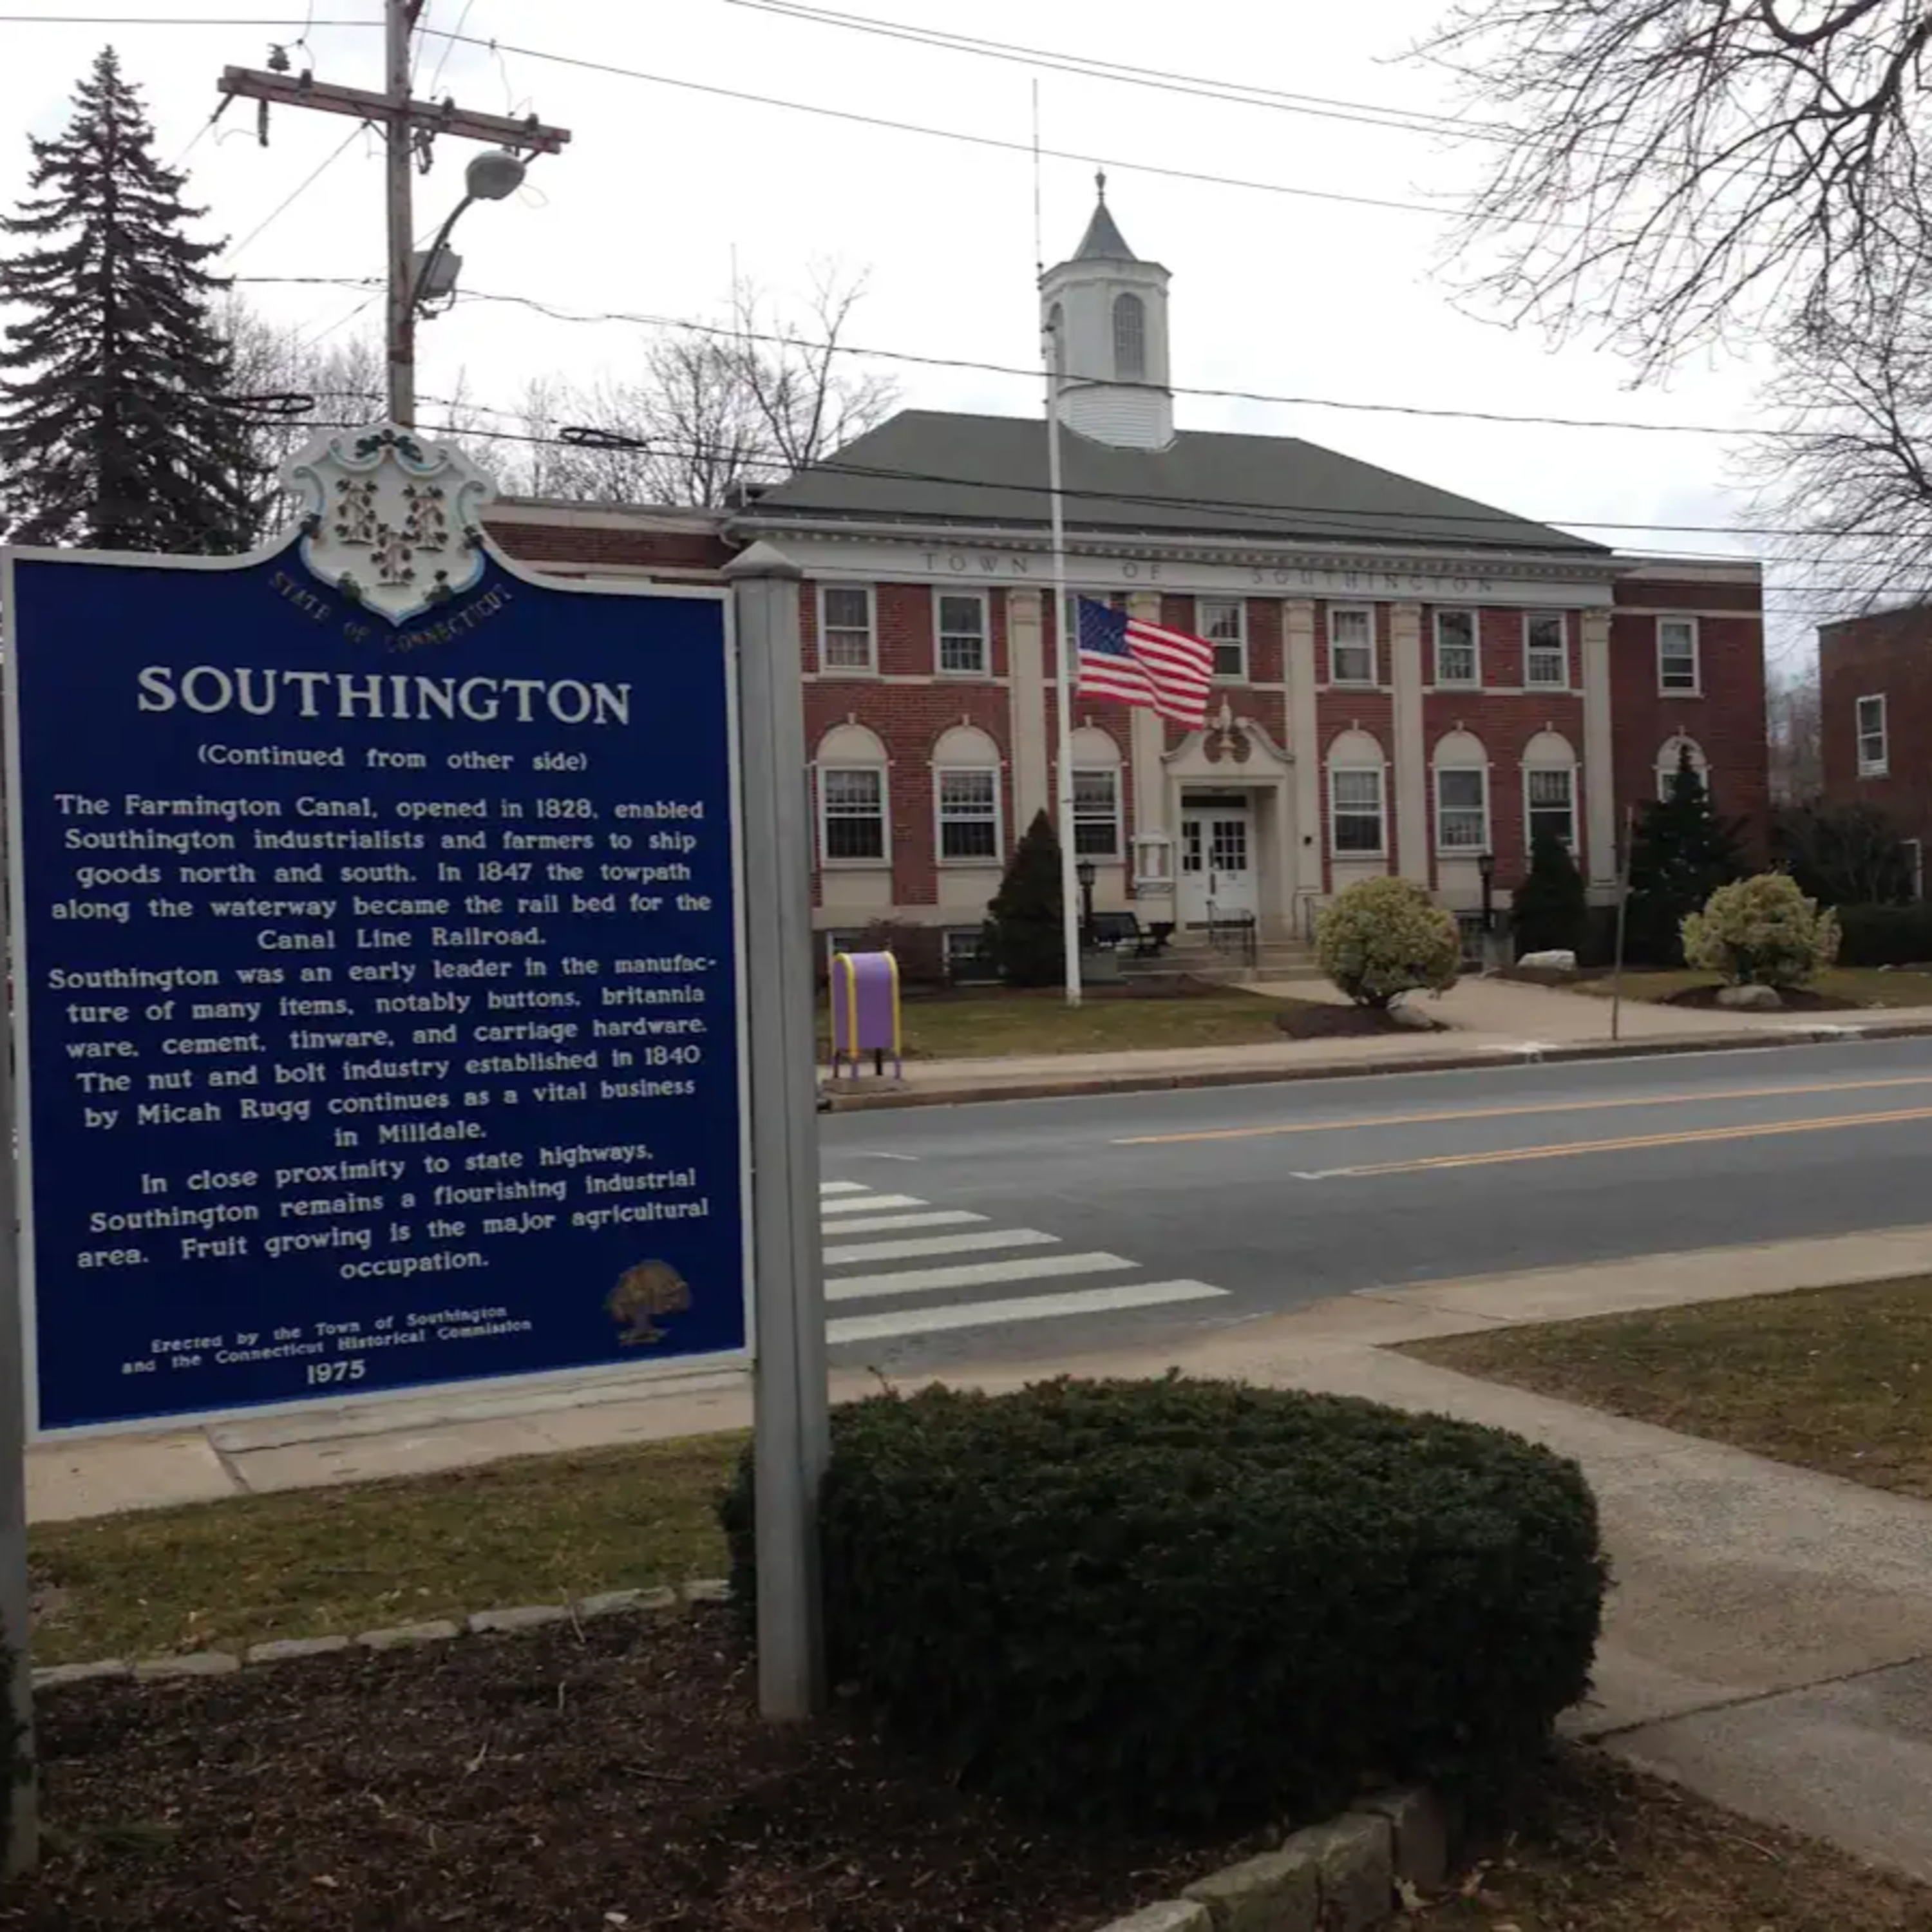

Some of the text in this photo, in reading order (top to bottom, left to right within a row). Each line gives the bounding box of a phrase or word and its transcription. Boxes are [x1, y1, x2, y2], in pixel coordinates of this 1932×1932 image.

[922, 552, 1492, 593] TOWN OF SOUTHINGTON
[269, 571, 513, 654] STATE OF CONNECTICUT
[137, 665, 632, 726] SOUTHINGTON
[197, 743, 588, 772] (Continued from other side)
[53, 793, 111, 815] The
[124, 793, 282, 823] Farmington
[395, 798, 488, 821] opened
[500, 798, 524, 819] in
[614, 800, 705, 820] enabled
[64, 827, 697, 856] Southington industrialists and farmers to ship
[75, 860, 692, 890] goods north and south. In 1847 the towpath
[51, 892, 712, 924] along the waterway became the rail bed for the
[256, 926, 547, 951] Canal Line Railroad.
[48, 953, 717, 993] Southington was an early leader in the manufac-
[65, 1003, 130, 1024] ture
[144, 999, 176, 1021] of
[191, 1001, 261, 1023] many
[375, 990, 471, 1014] notably
[601, 983, 706, 1006] britannia
[412, 1023, 458, 1045] and
[473, 1021, 579, 1045] carriage
[75, 1044, 701, 1094] The nut and bolt industry established in 1840
[84, 1078, 696, 1130] by Micah Rugg continues as a vital business
[334, 1119, 487, 1148] in Milldale.
[141, 1173, 168, 1195] In
[186, 1169, 259, 1191] close
[274, 1158, 406, 1189] proximity
[422, 1155, 451, 1174] to
[464, 1151, 524, 1171] state
[89, 1167, 697, 1233] Southington remains a flourishing industrial
[77, 1197, 709, 1269] area. Fruit growing is the major agricultural
[339, 1250, 489, 1280] occupation.
[121, 1317, 532, 1375] and the Connecticut Historical Commission
[151, 1307, 507, 1354] Erected by the Town of Southington
[307, 1358, 366, 1385] 1975
